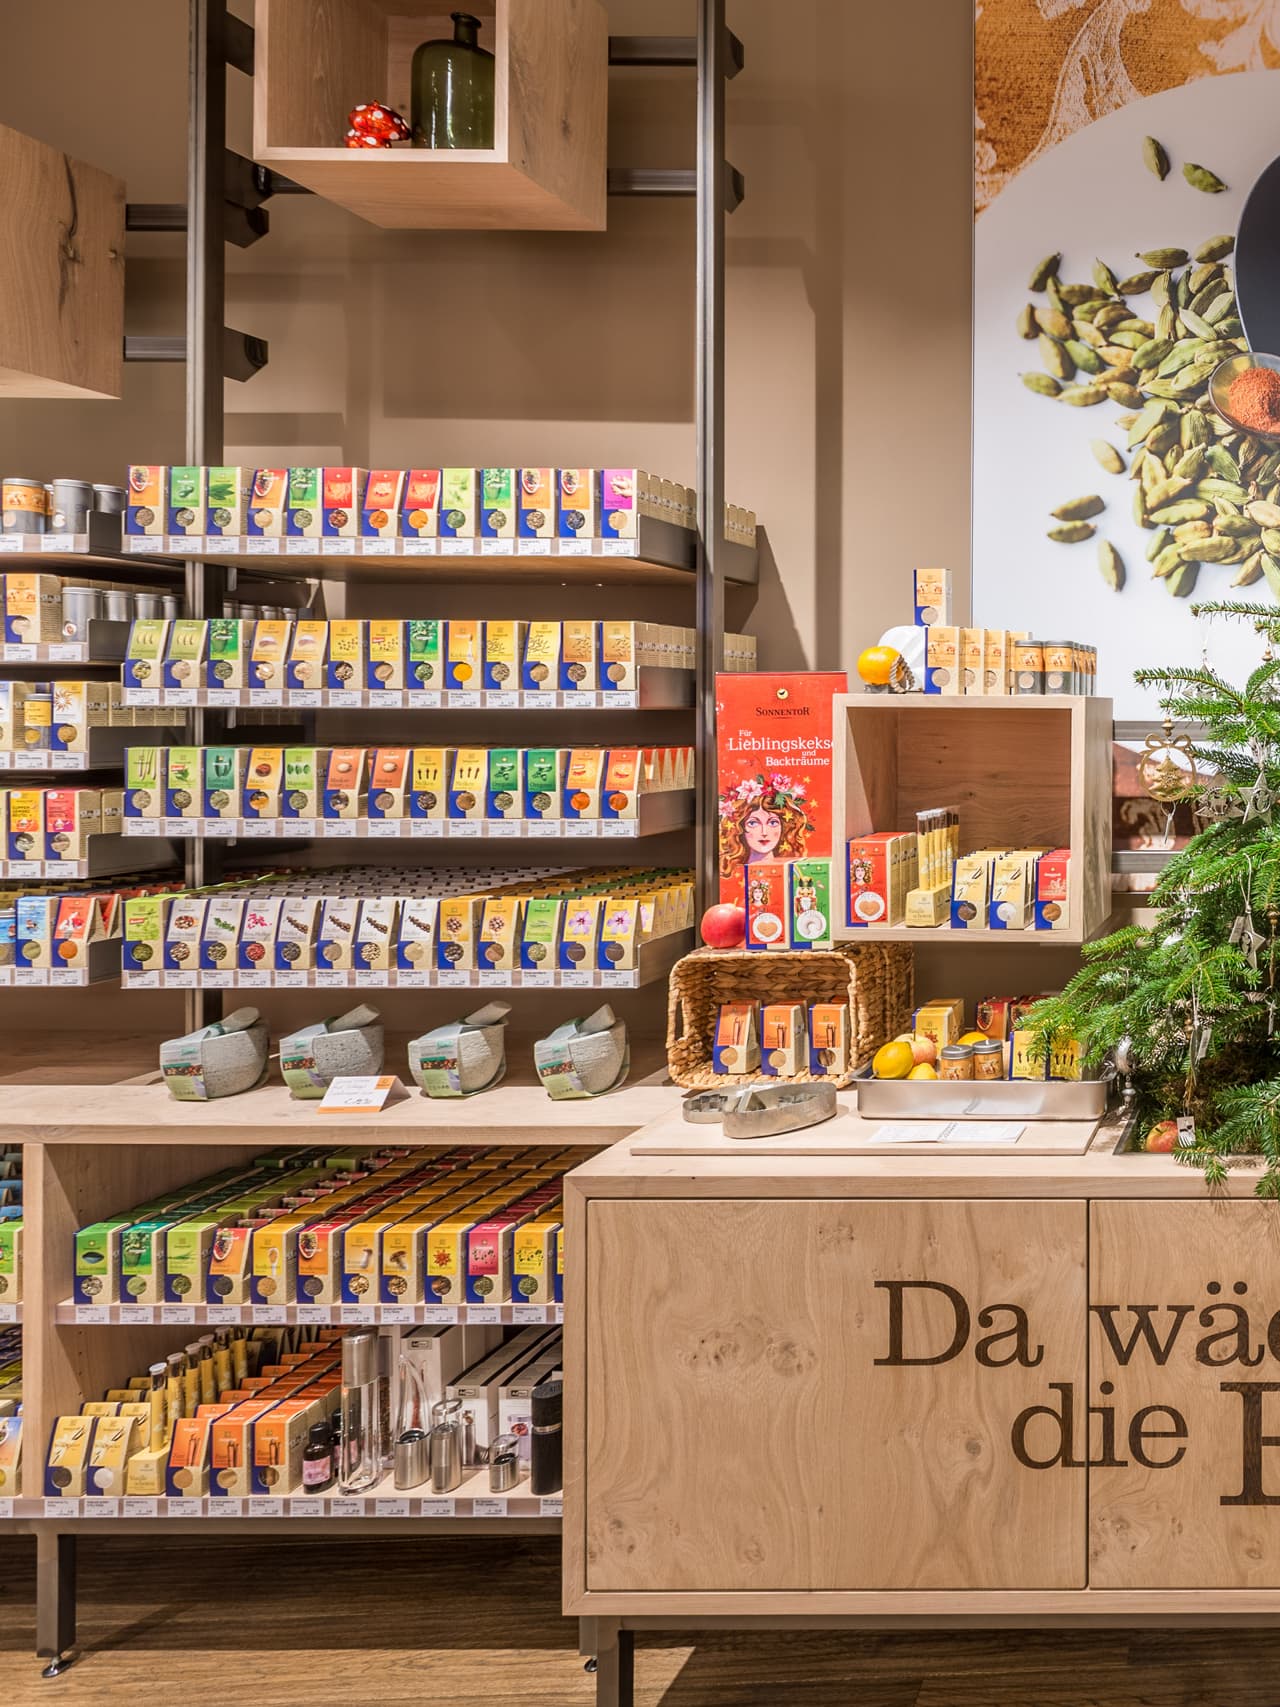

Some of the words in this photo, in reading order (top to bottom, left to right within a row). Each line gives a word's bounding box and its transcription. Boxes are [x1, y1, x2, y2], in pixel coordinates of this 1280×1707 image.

[756, 706, 810, 716] SONNENTOR
[766, 756, 830, 766] Backträume
[873, 1280, 1044, 1368] Da
[1011, 1381, 1189, 1470] die
